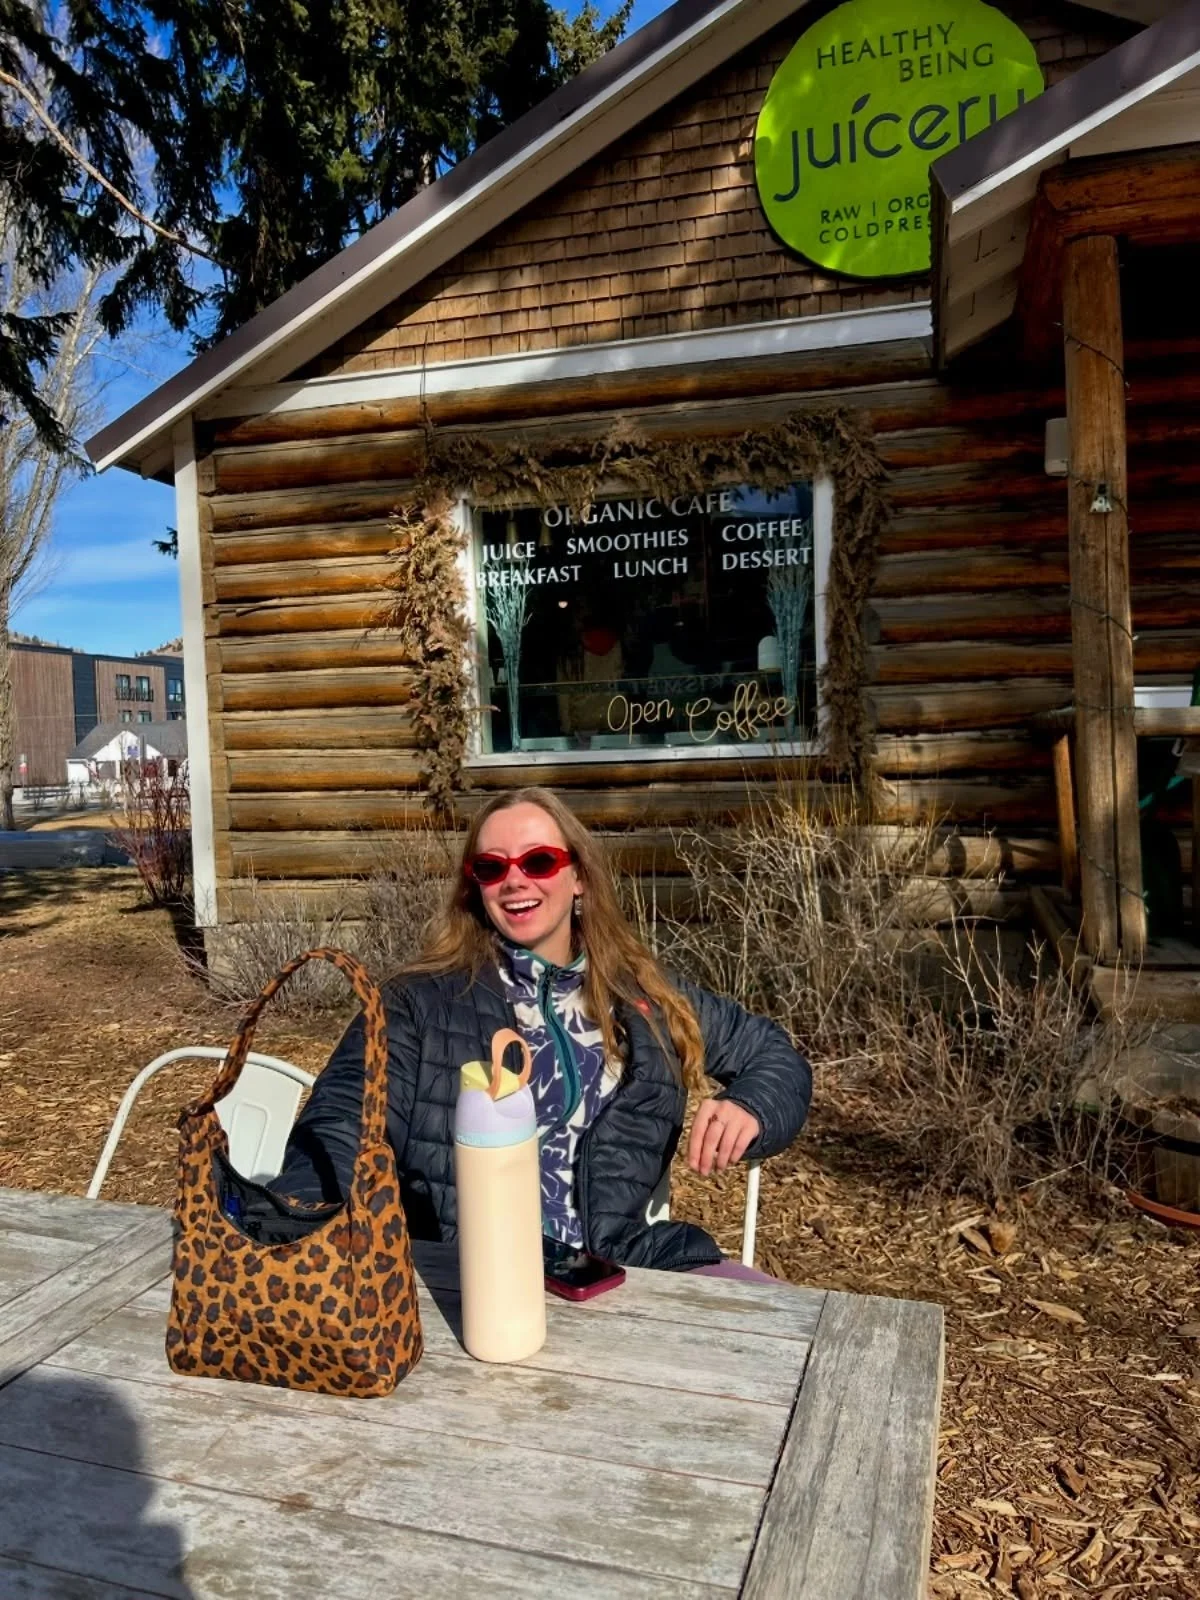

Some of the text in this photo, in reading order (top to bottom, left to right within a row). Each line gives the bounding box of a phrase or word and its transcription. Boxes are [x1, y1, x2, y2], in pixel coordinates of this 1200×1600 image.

[817, 21, 955, 69] HEALTHY
[900, 43, 994, 82] BEING
[821, 205, 861, 224] RAW
[671, 491, 733, 517] CAFE
[481, 519, 802, 564] JUICE SMOOTHIES COFFEE
[475, 547, 812, 588] BREAKFAST LUNCH DESSERT
[607, 680, 795, 745] Open Coffee
